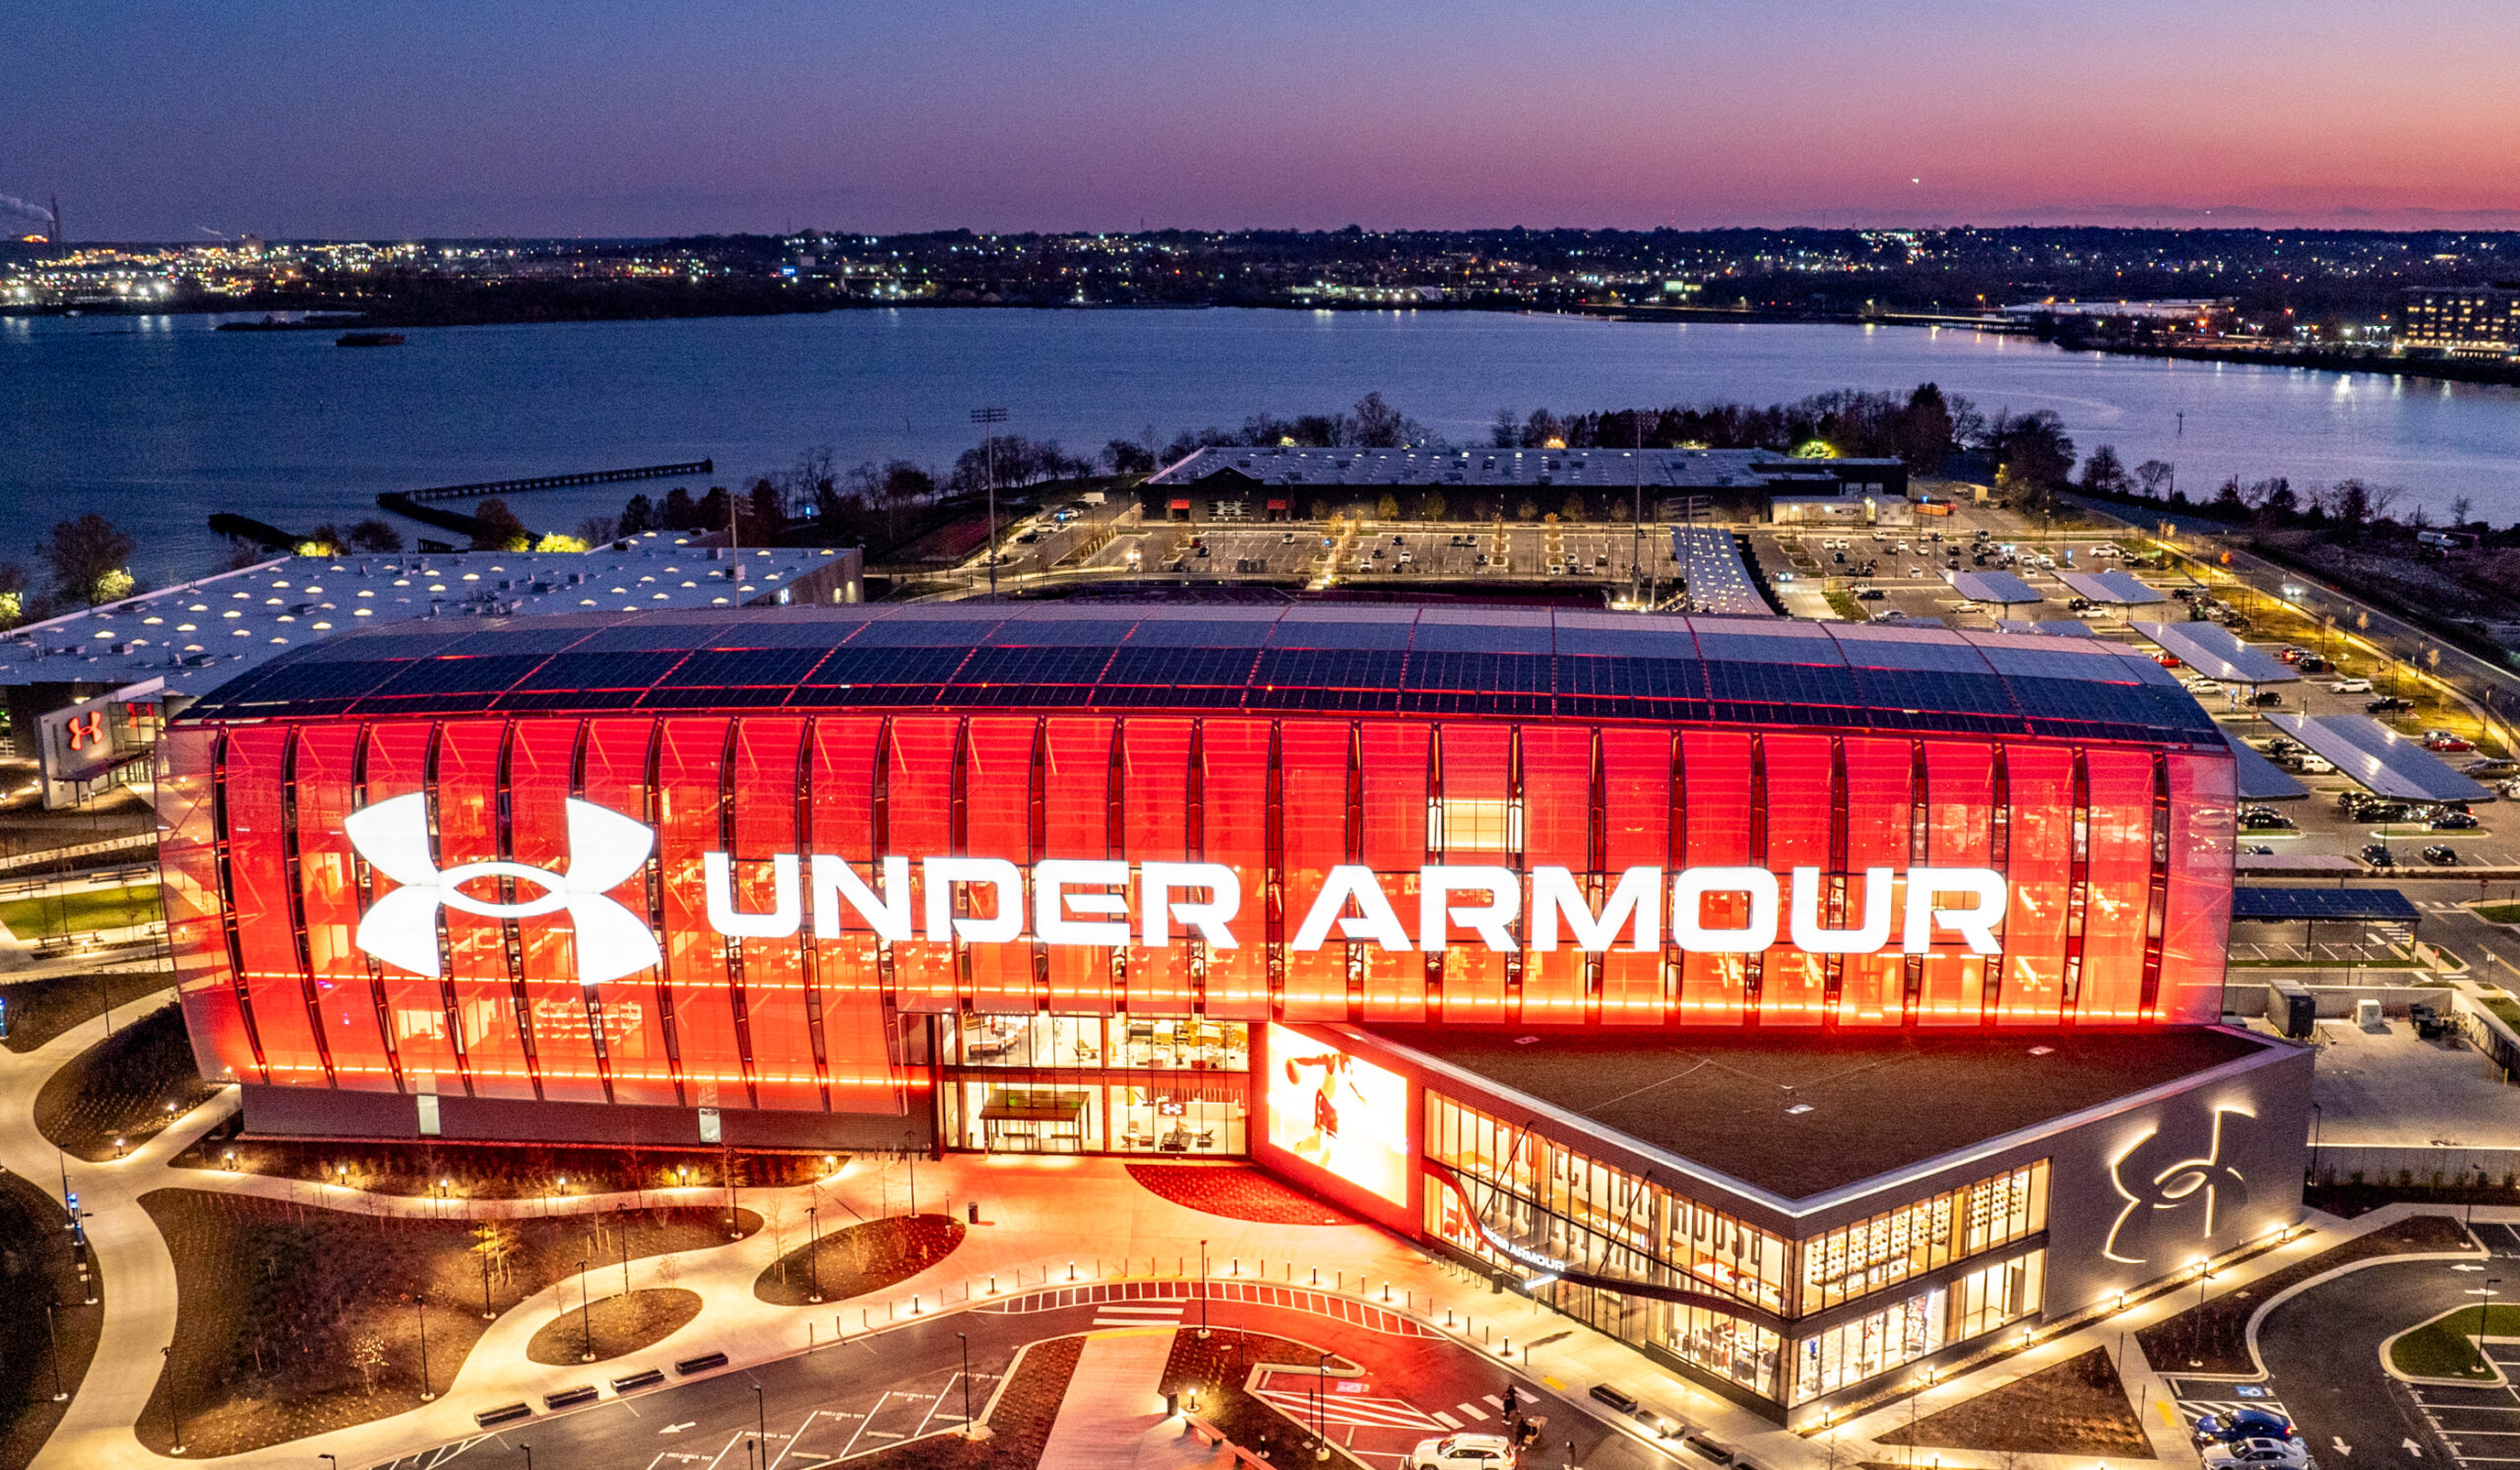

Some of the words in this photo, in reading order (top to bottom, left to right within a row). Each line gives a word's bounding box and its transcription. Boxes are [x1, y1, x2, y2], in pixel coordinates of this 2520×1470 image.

[704, 852, 1240, 949] UNDER
[1292, 864, 2008, 954] ARMOUR
[1509, 1245, 1565, 1272] ARMOUR
